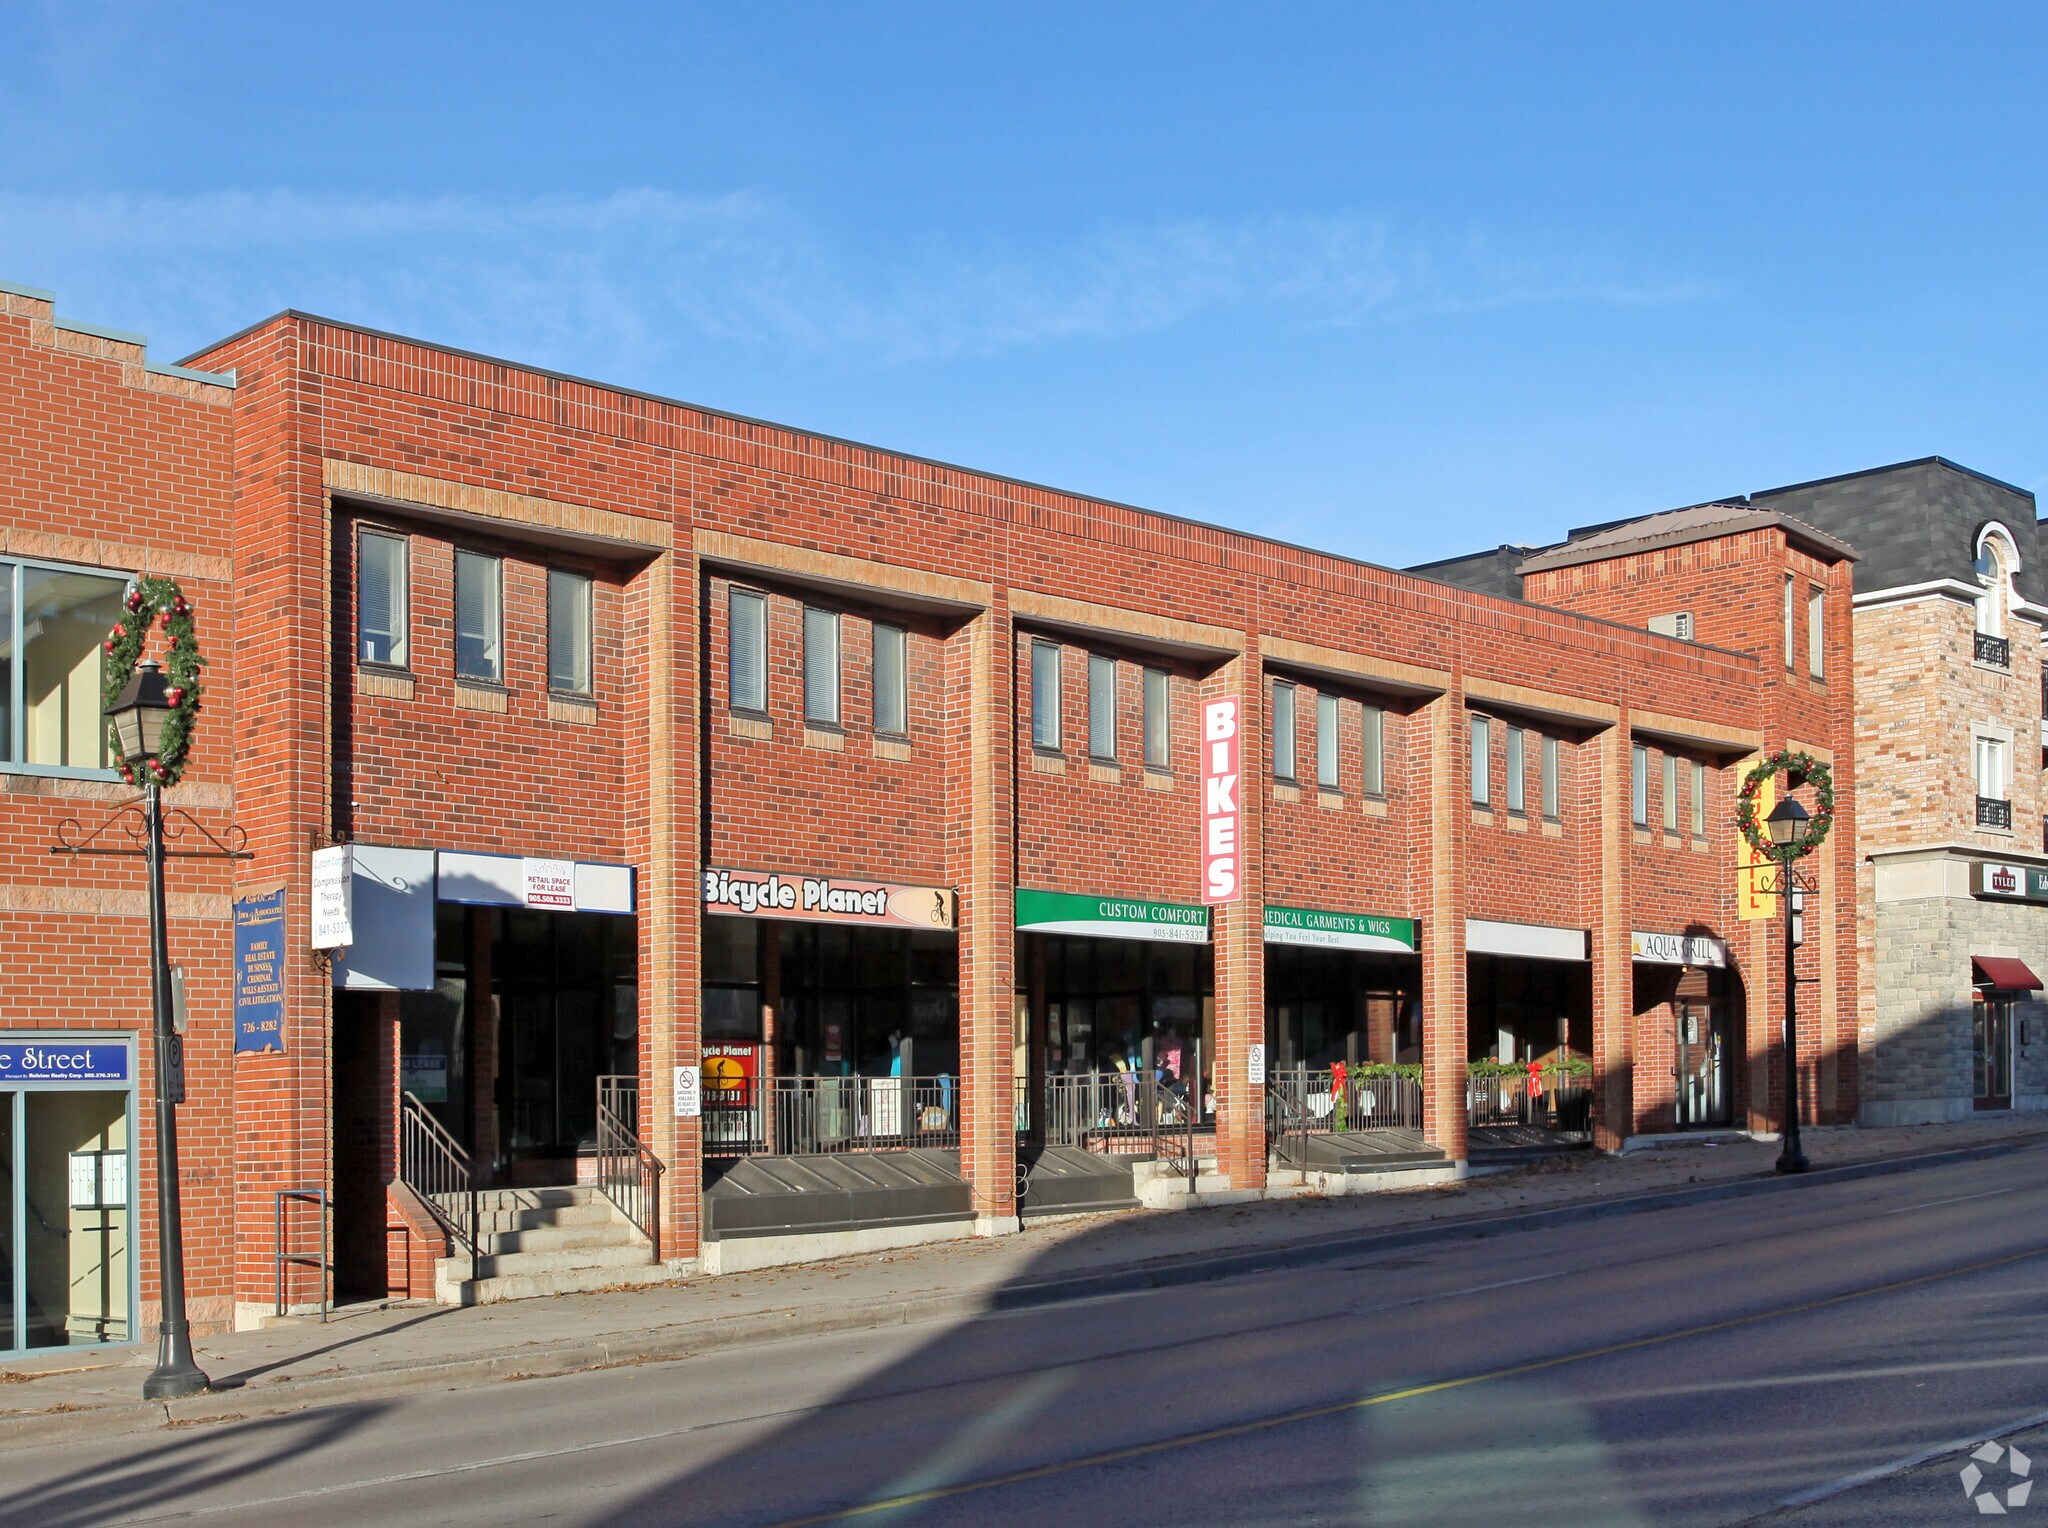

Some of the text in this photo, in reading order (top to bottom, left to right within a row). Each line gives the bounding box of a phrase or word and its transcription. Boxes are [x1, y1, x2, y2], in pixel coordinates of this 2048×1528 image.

[1206, 701, 1237, 897] BIKES
[313, 876, 350, 888] Compression
[551, 877, 571, 885] SPACE
[1750, 843, 1761, 908] RILL
[1993, 876, 2015, 887] TYLER
[2038, 874, 2048, 890] Ed
[320, 892, 343, 903] Therapy
[705, 870, 887, 915] Bicycle Planet
[323, 907, 340, 917] Needs
[1099, 902, 1204, 924] CUSTOM COMFORT
[319, 921, 349, 936] 841-5337
[1306, 914, 1355, 931] GARMENTS
[1358, 919, 1365, 931] &
[1368, 920, 1390, 934] WIGS
[1153, 928, 1204, 941] 905-841-5337
[1264, 929, 1340, 943] elping You Feel Your Best
[251, 941, 268, 951] FAMILY
[1646, 935, 1712, 960] AQUA GRILL
[245, 951, 276, 962] REAL ESTATE
[247, 962, 271, 972] BUSINESS
[247, 974, 272, 983] CRIMINAL
[242, 985, 257, 994] WILLS
[239, 993, 282, 1006] CIVIL LITIGATION
[242, 1021, 256, 1034] 726
[261, 1020, 277, 1032] 8282
[723, 1045, 752, 1056] Planet
[22, 1047, 95, 1069] Street
[412, 1060, 440, 1068] LEASE
